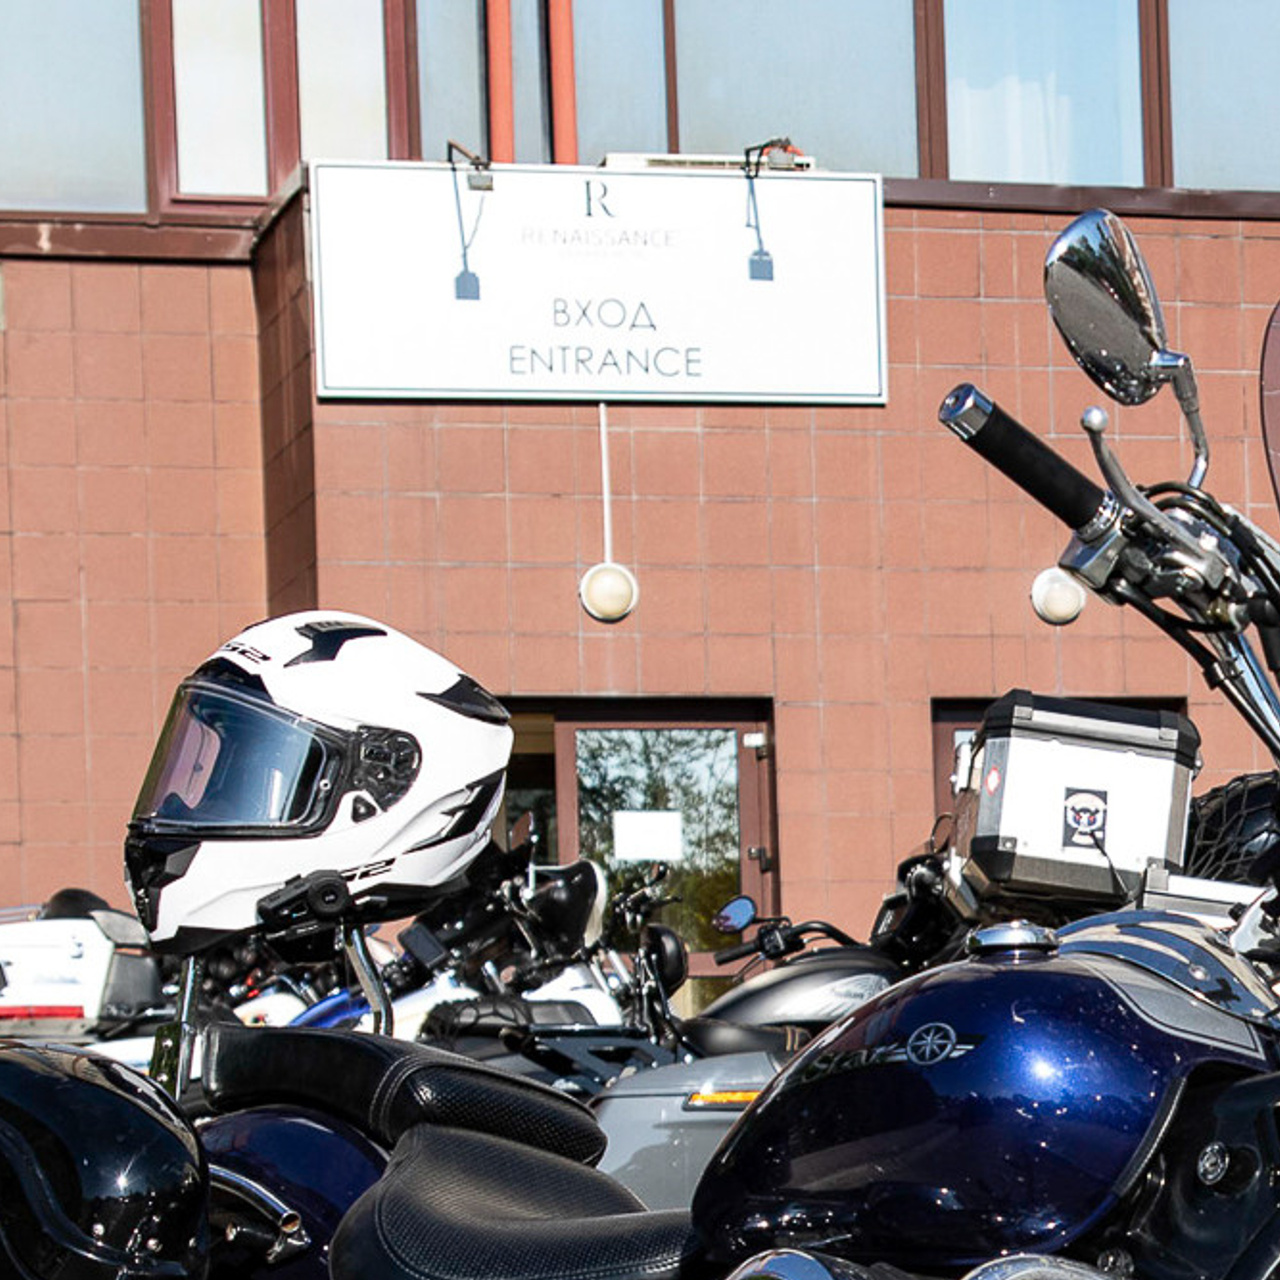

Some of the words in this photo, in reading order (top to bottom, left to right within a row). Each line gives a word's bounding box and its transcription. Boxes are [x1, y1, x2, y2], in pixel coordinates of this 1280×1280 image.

[583, 180, 616, 217] R
[520, 226, 677, 247] RENAISSANCE
[552, 297, 657, 331] ВХОД
[510, 345, 702, 378] ENTRANCE
